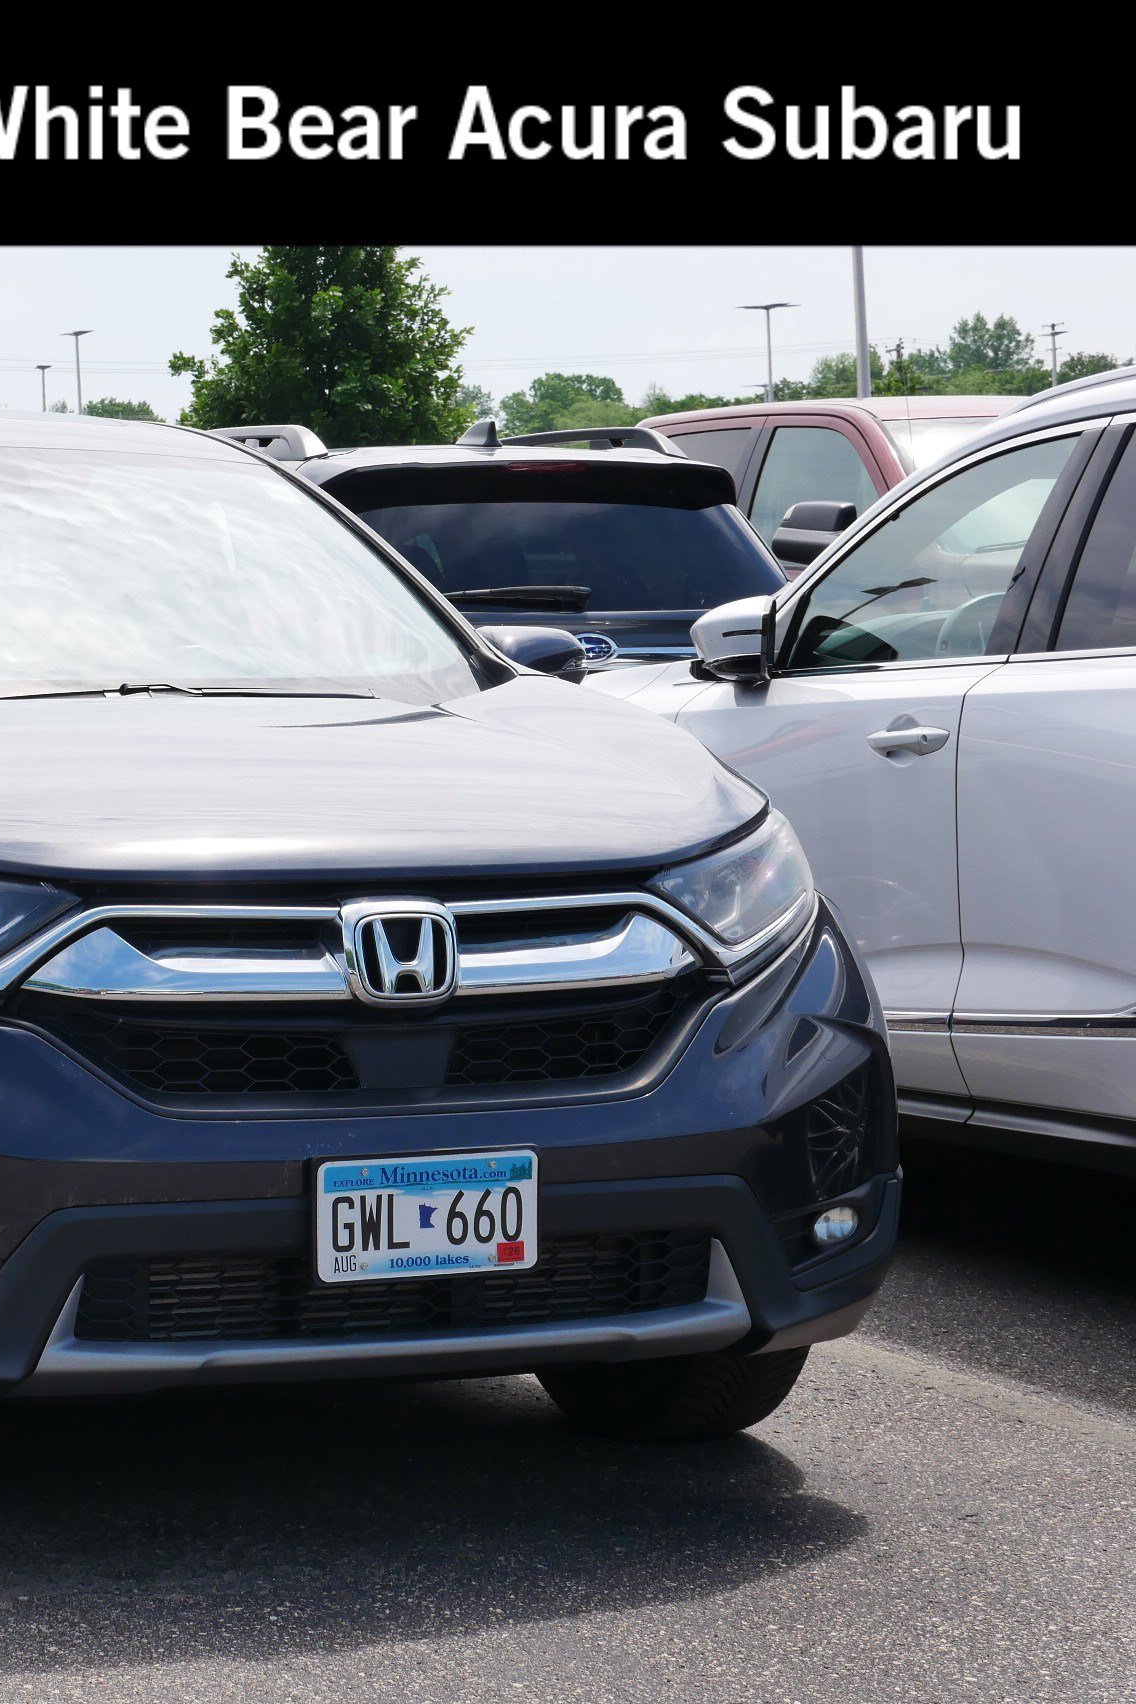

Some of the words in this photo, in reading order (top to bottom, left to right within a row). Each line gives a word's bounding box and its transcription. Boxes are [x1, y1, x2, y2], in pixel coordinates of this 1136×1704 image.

[333, 1179, 375, 1188] EXPLORE
[332, 1193, 411, 1252] GWL
[446, 1186, 523, 1246] 660
[333, 1255, 357, 1274] AUG
[389, 1256, 431, 1269] 10,000
[435, 1254, 470, 1266] lakes
